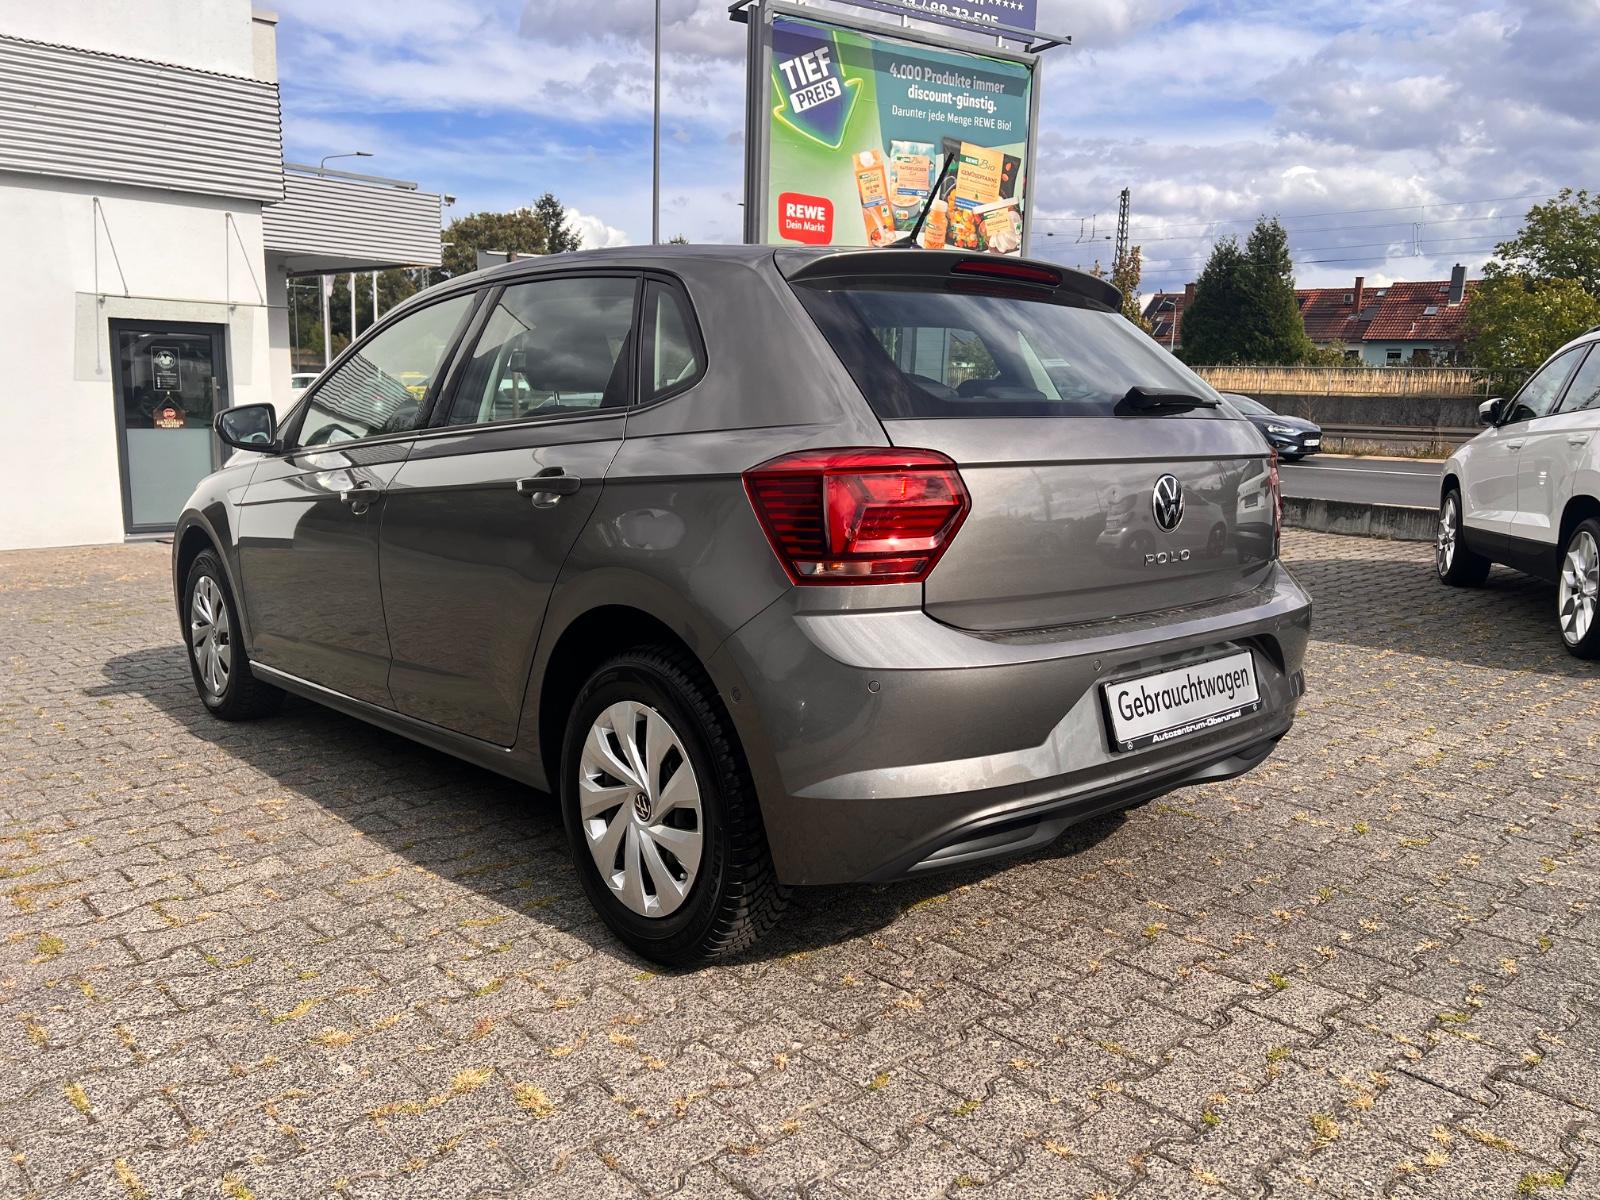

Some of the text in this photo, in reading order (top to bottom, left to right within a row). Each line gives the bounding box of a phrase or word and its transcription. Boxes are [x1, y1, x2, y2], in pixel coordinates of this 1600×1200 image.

[779, 46, 831, 90] TIEF
[889, 62, 1005, 94] 4.000 Produkte immer
[795, 80, 836, 109] PREIS
[907, 84, 998, 113] discount-günstig.
[891, 105, 1012, 131] Darunter jede Menge REWE Bio!
[979, 158, 996, 172] Bio
[786, 203, 826, 220] REWE
[786, 219, 825, 232] Dein Markt
[1143, 548, 1191, 567] POLO
[1117, 667, 1250, 721] Gebrauchtwagen
[1152, 710, 1242, 743] Autozentrum-Oberursel
